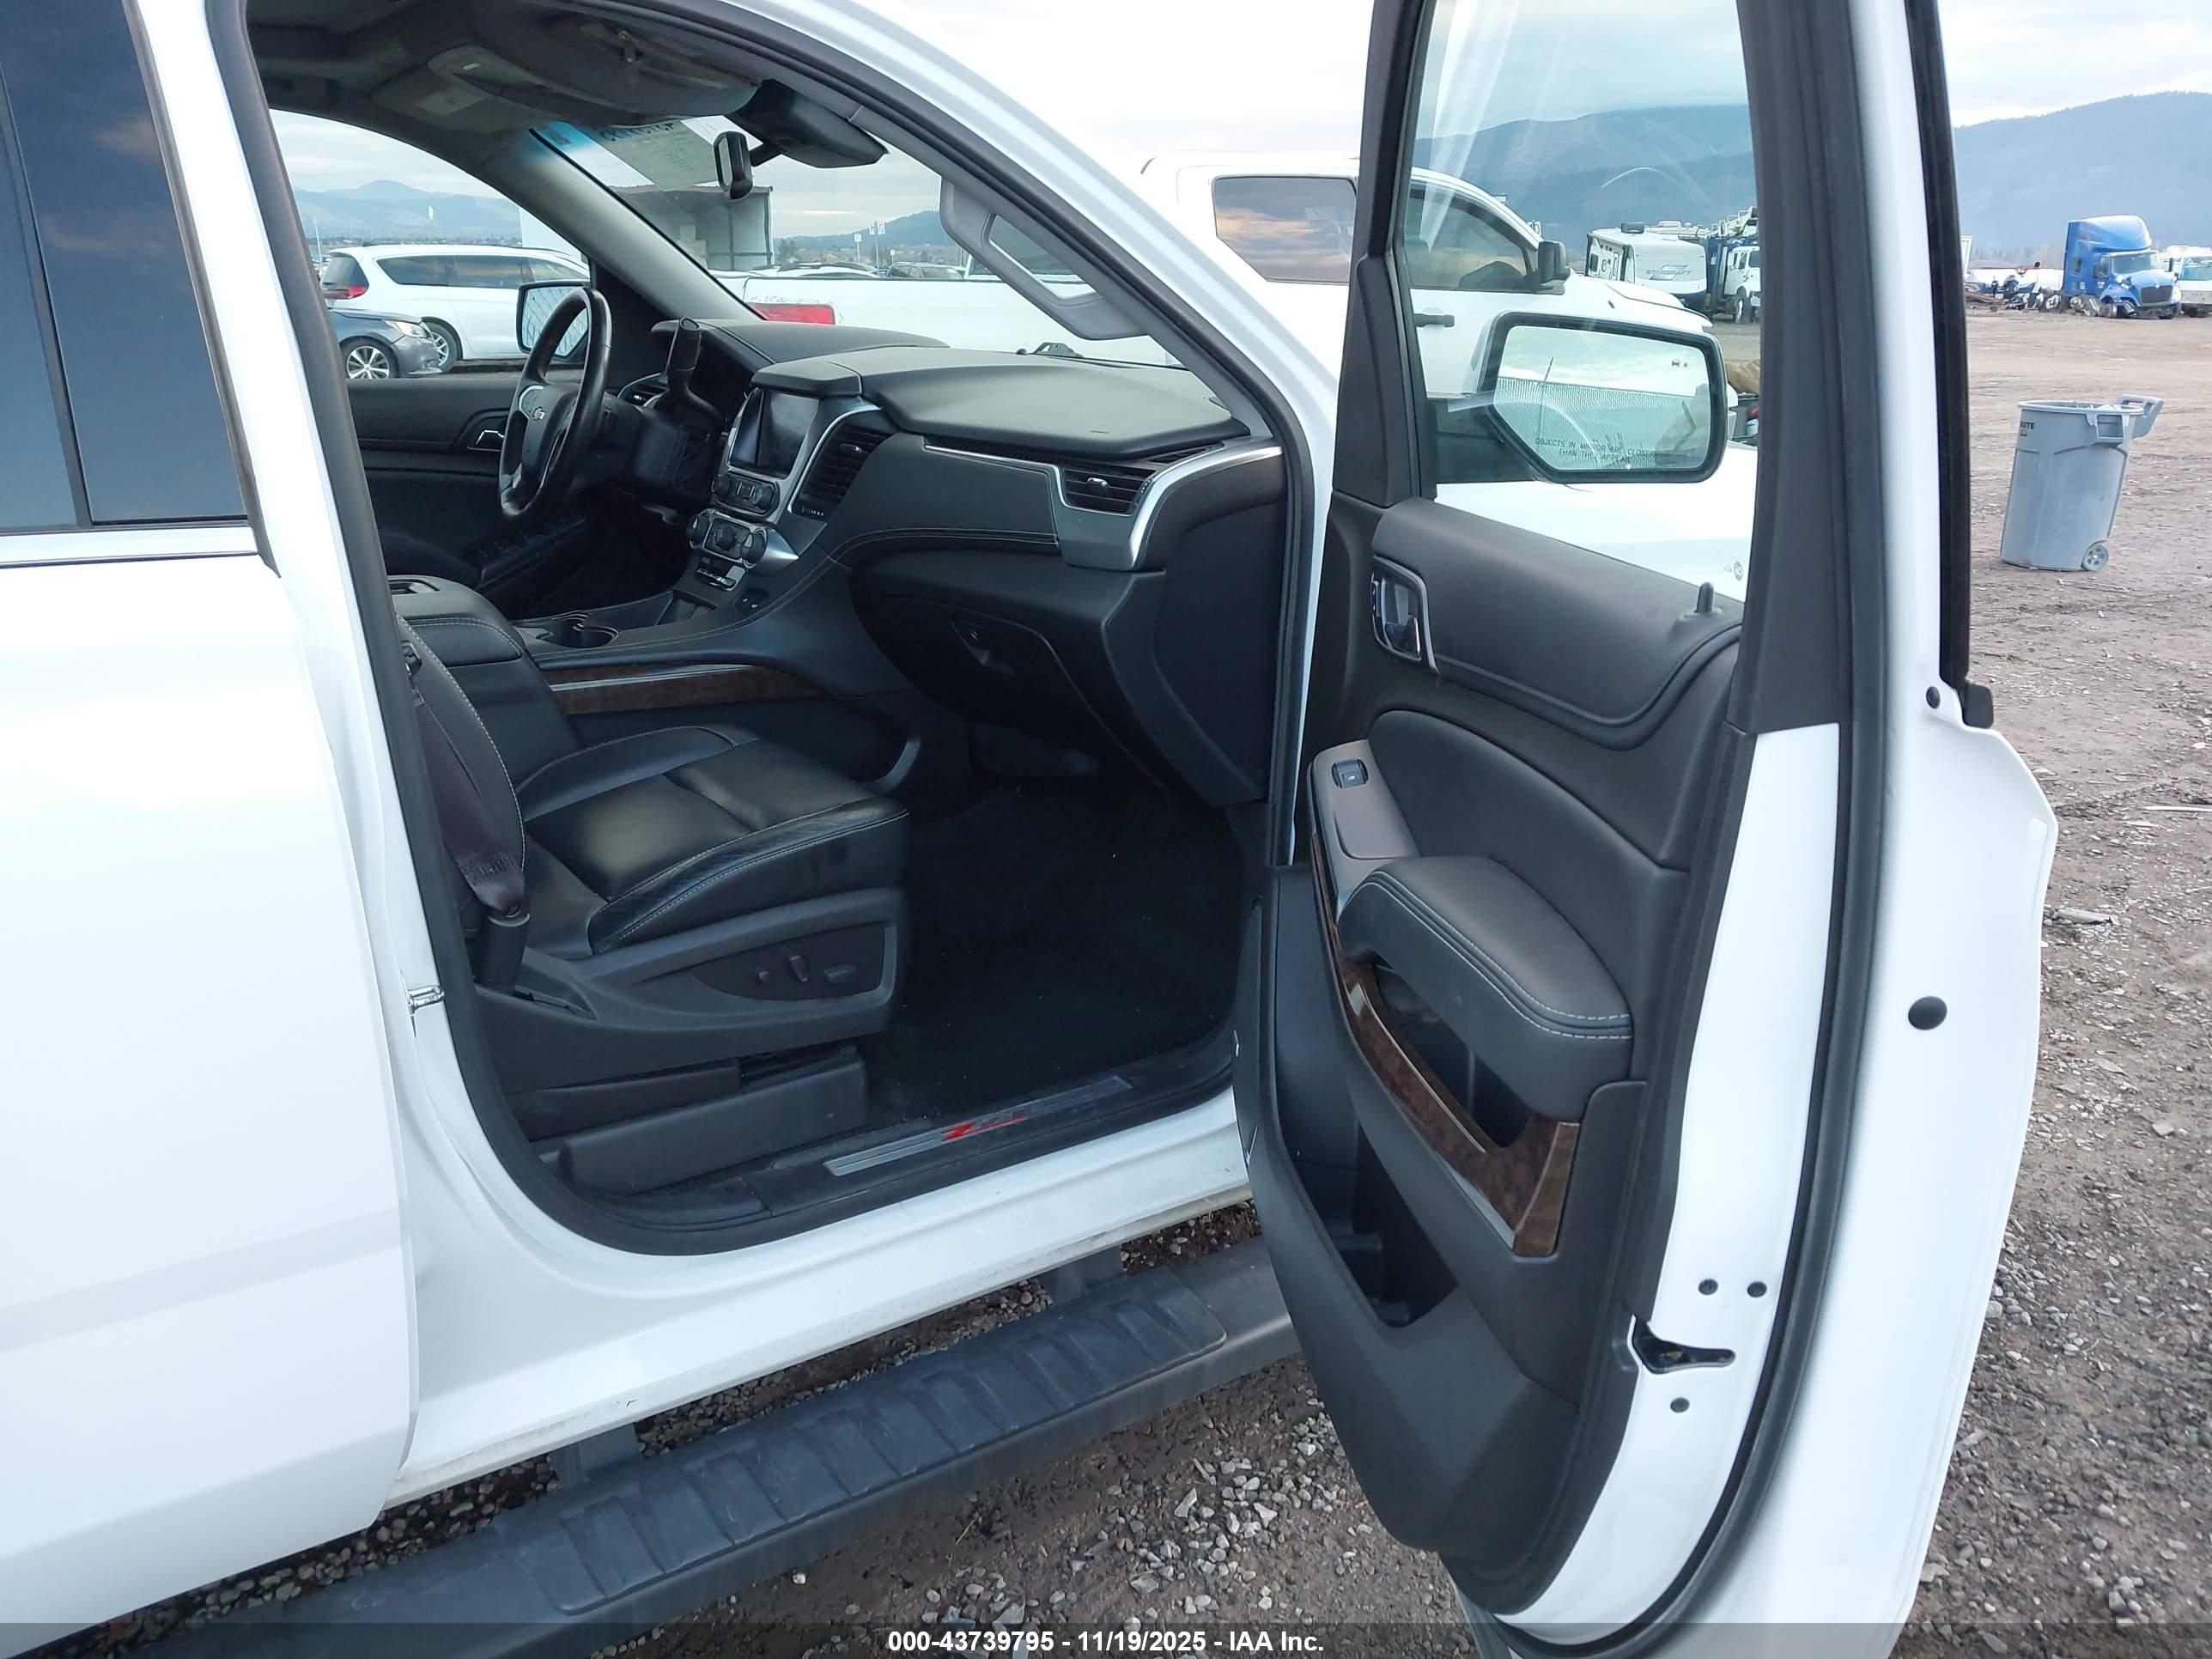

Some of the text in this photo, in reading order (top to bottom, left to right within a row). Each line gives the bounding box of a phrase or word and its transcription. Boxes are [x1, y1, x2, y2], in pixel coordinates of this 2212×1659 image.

[1534, 437, 1565, 448] OBJECTS
[1608, 445, 1623, 454] ARE
[1559, 447, 1577, 458] THAN
